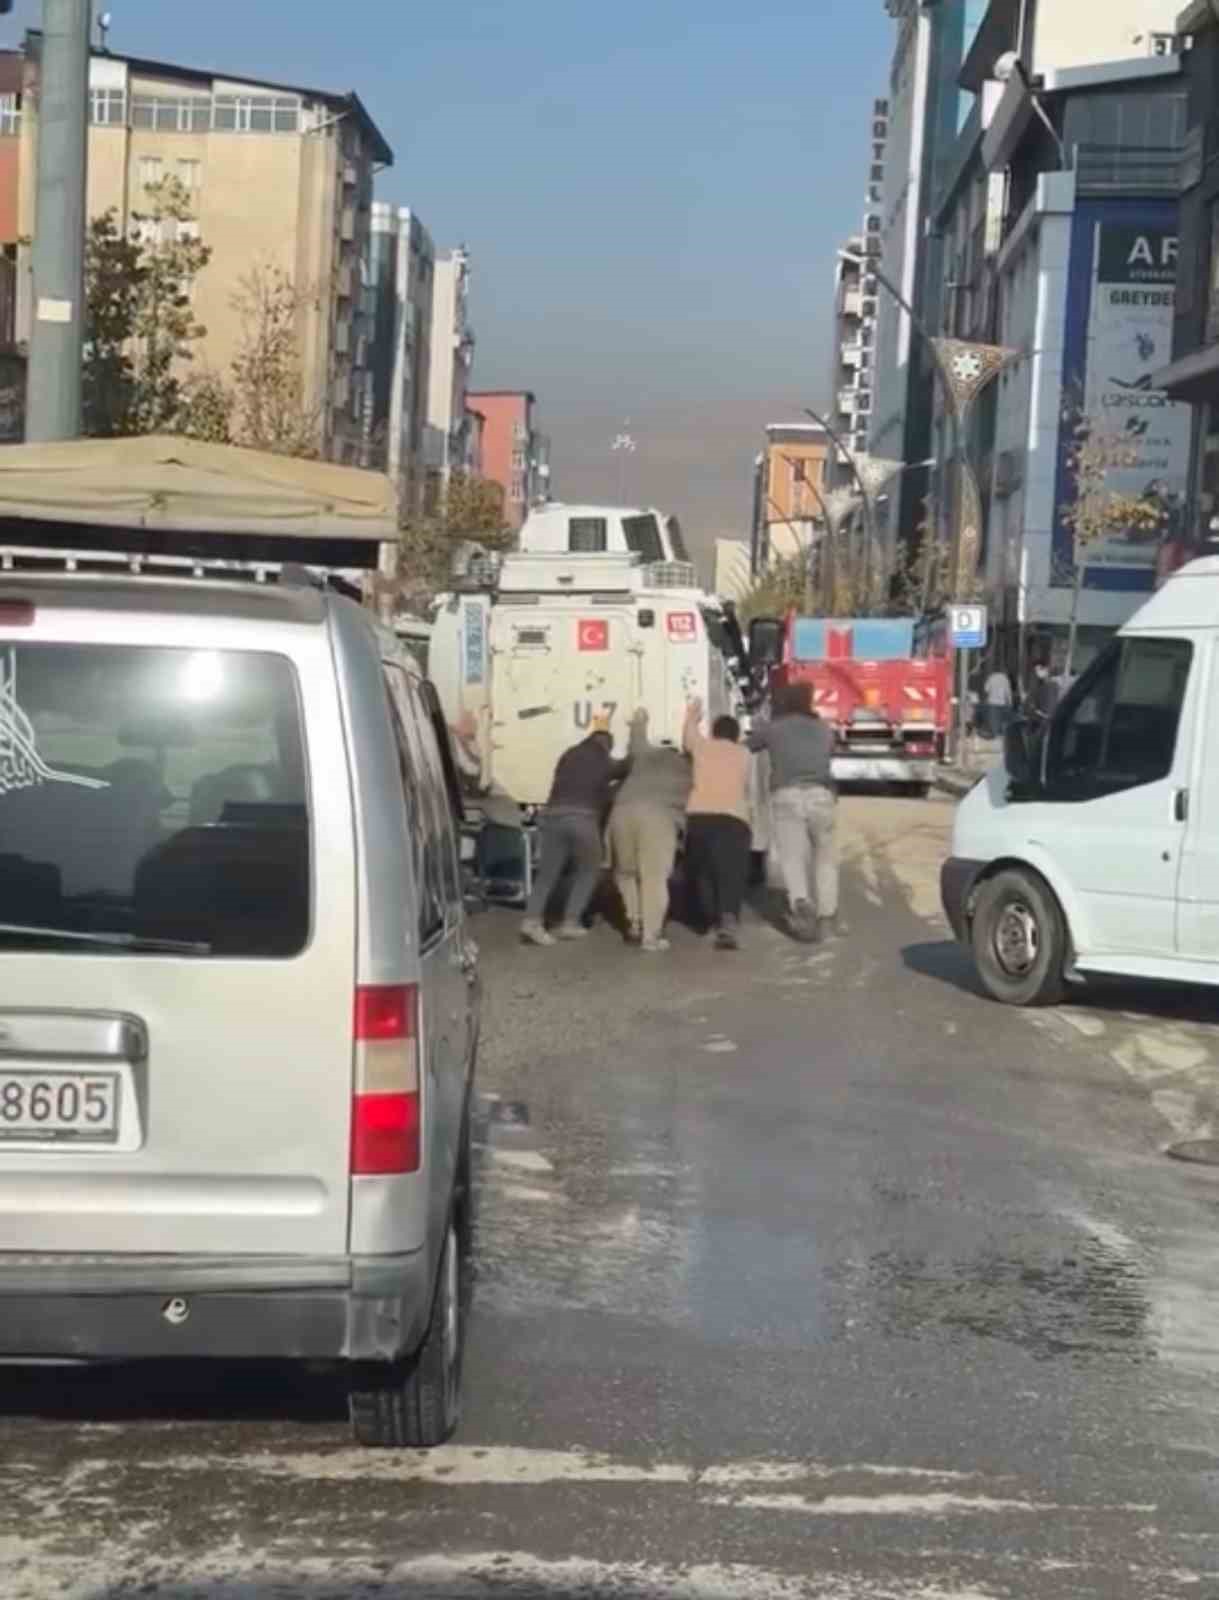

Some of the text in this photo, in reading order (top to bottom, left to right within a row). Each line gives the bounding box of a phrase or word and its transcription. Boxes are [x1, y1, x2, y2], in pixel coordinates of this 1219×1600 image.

[869, 98, 888, 202] HOTEL
[1110, 289, 1176, 305] GREYDE
[2, 1081, 107, 1121] 8605
